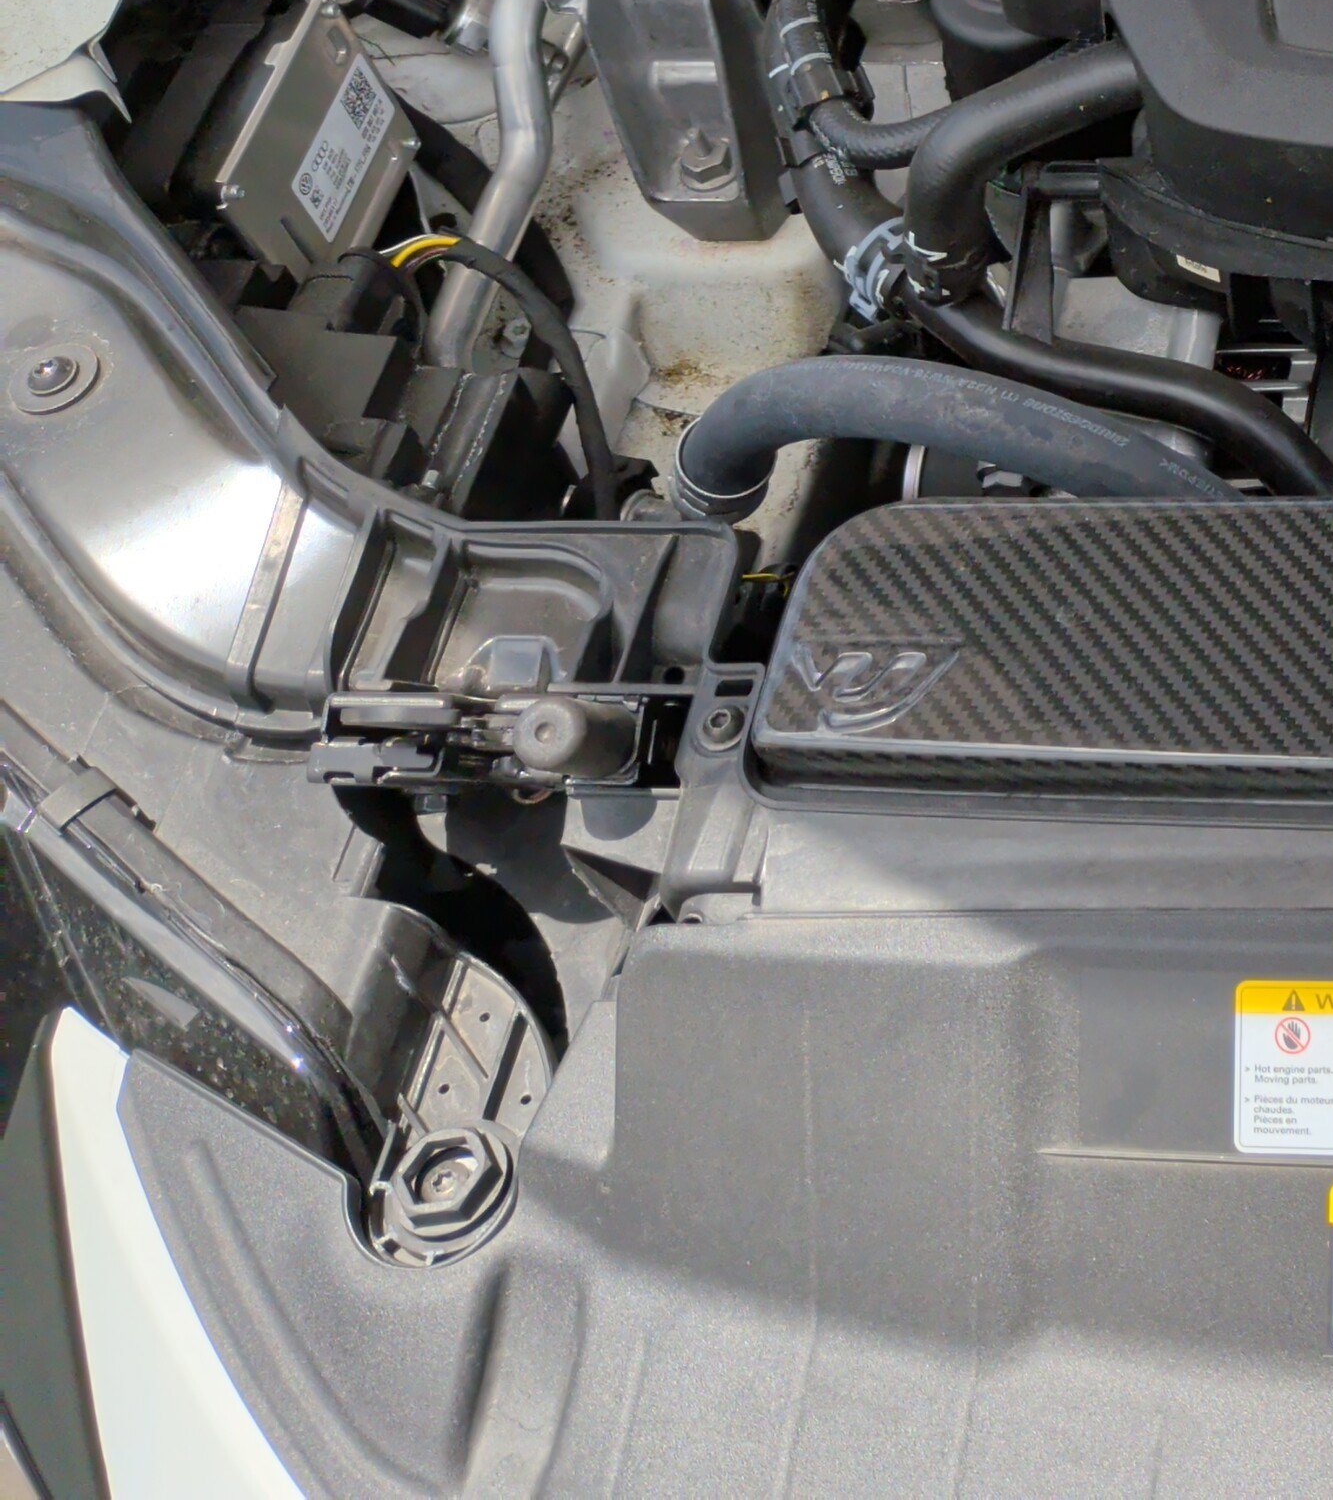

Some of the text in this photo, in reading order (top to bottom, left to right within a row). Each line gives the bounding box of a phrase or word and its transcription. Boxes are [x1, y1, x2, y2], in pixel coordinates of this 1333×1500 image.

[1254, 1064, 1333, 1075] Hot engine parts.
[1254, 1075, 1317, 1085] Moving parts.
[1254, 1095, 1283, 1104] Pièces
[1286, 1096, 1298, 1104] du
[1254, 1106, 1295, 1114] chaudes.
[1254, 1115, 1283, 1124] Pièces
[1254, 1126, 1311, 1135] mouvement.
